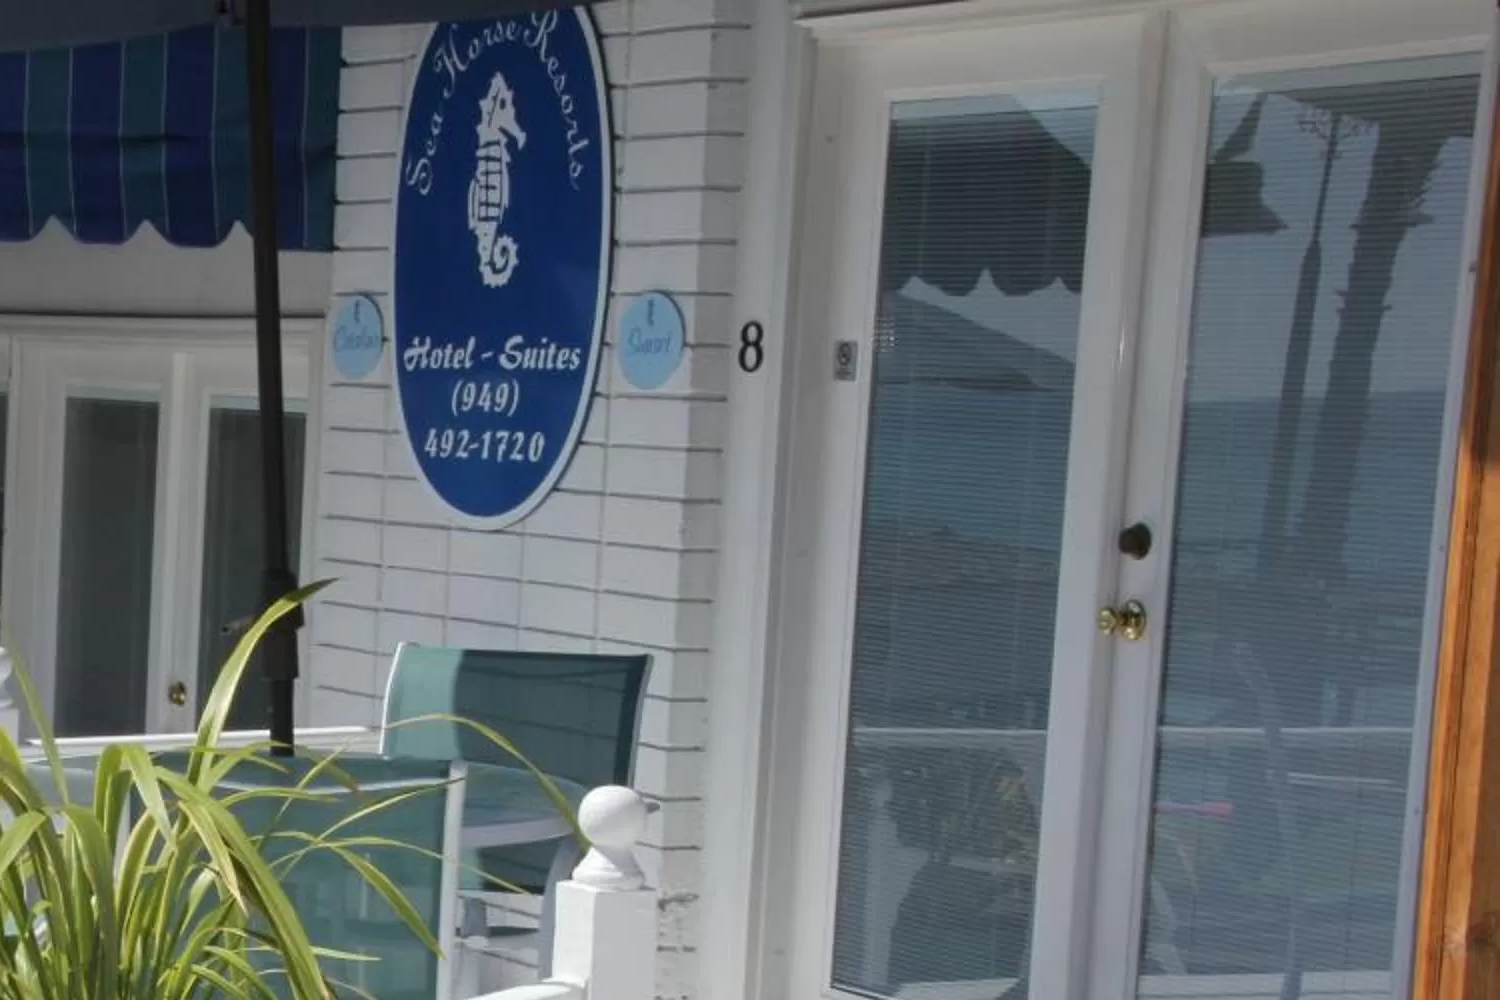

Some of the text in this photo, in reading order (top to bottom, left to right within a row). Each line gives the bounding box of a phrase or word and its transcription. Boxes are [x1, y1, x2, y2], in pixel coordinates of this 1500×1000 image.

[405, 8, 589, 196] Sea Horse Resorts
[403, 335, 476, 372] Hotel
[500, 334, 582, 370] Suites
[738, 319, 764, 373] 8
[451, 379, 519, 417] (949)
[424, 428, 545, 463] 492-1720
